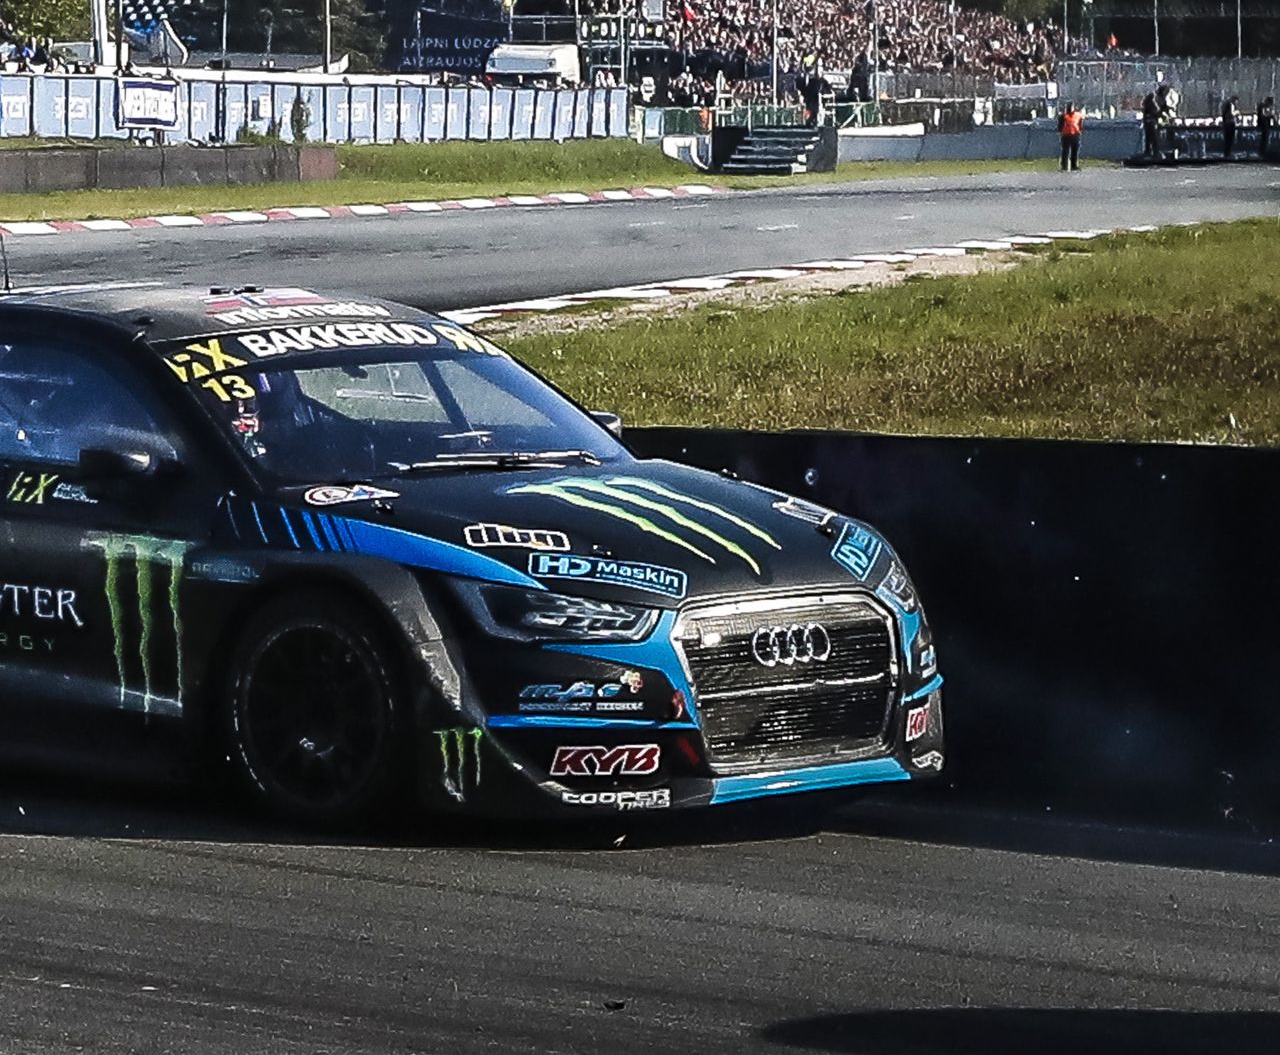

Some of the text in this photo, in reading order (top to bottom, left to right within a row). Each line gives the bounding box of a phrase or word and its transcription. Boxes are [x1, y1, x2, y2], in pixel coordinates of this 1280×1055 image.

[213, 300, 391, 324] informativ
[238, 323, 438, 358] BAKKERUD
[201, 374, 255, 402] 13
[537, 555, 679, 589] HD Maskin
[549, 743, 661, 776] KYB
[562, 788, 670, 804] COOPER
